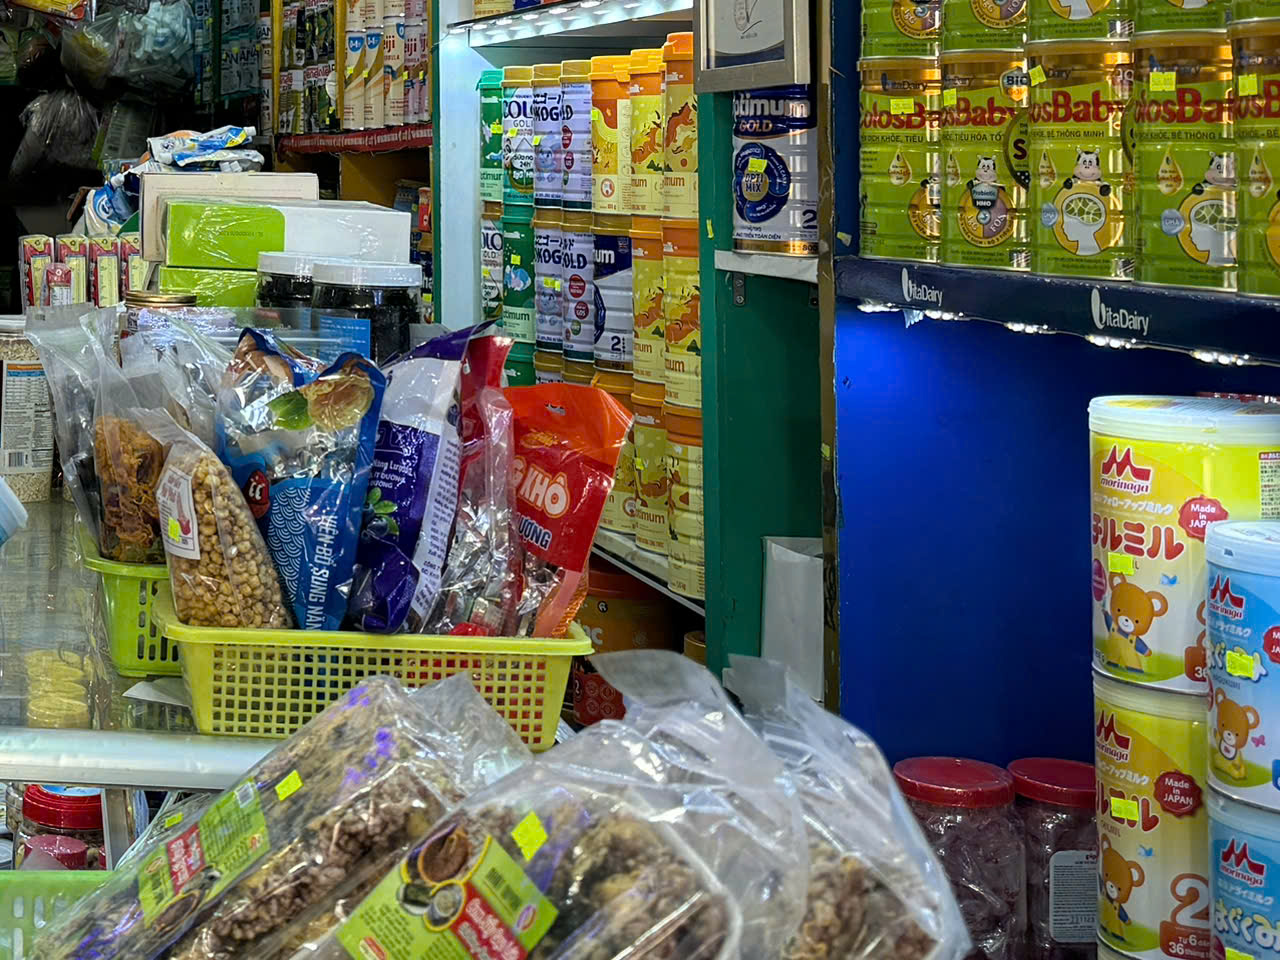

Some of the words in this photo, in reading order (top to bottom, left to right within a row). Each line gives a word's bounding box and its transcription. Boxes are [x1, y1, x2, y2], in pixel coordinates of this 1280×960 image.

[739, 119, 773, 132] GOLD
[1083, 130, 1105, 138] MINH
[745, 182, 762, 192] MIX
[802, 209, 818, 229] 2
[901, 267, 943, 306] VitaDairy
[1091, 288, 1150, 334] VitaDairy
[519, 464, 569, 517] KHÔ
[1100, 478, 1150, 494] morinaga
[1190, 503, 1216, 514] Made
[308, 568, 329, 603] SUNG
[1165, 777, 1190, 789] Made
[1163, 793, 1194, 807] JAPAN
[1220, 865, 1264, 888] morinaga
[1170, 873, 1209, 928] 2
[1169, 941, 1185, 956] 36
